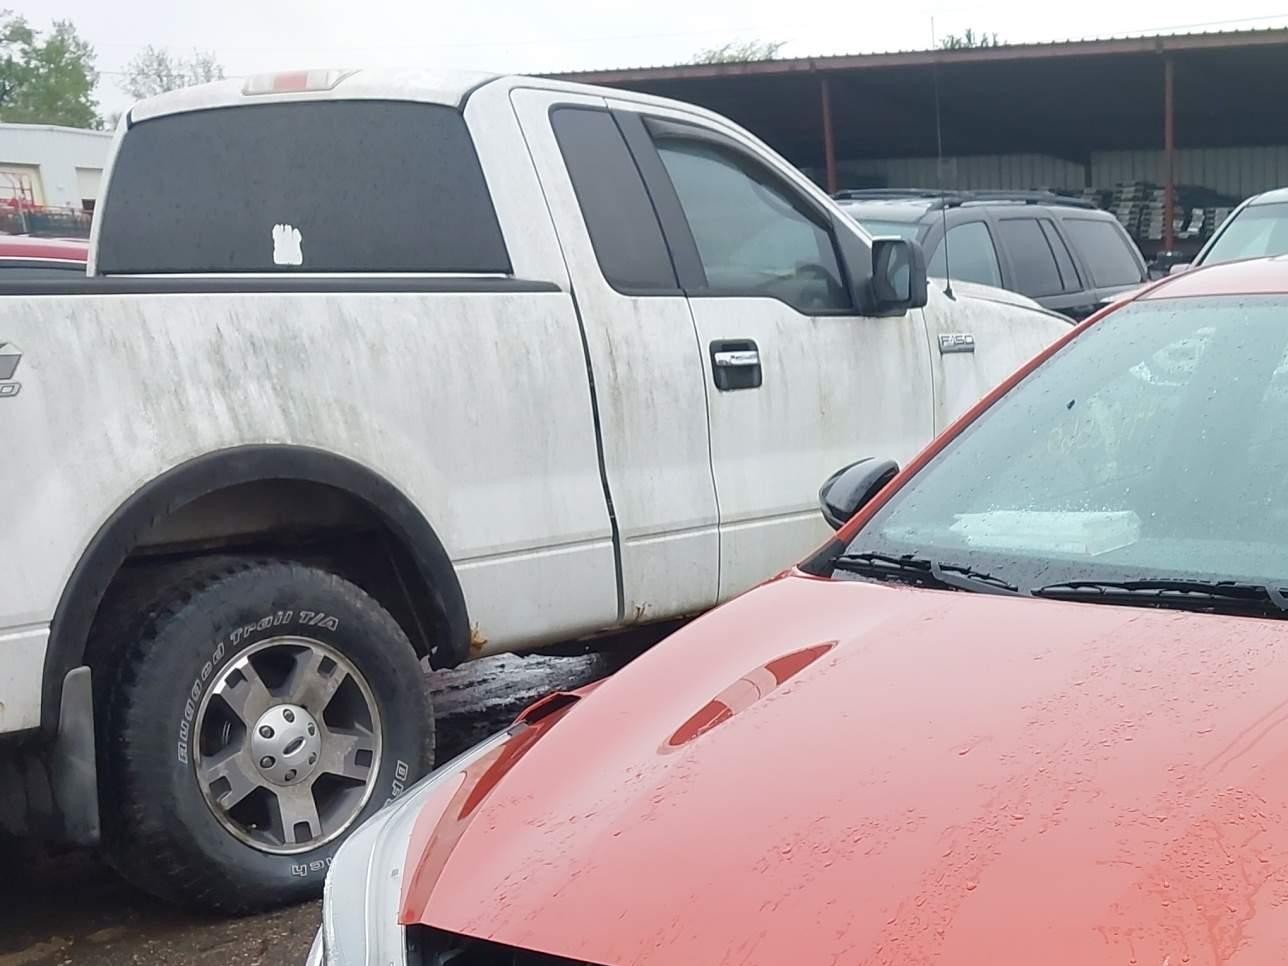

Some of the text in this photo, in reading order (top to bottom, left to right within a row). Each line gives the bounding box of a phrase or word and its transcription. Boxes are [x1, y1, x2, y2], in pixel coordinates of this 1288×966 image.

[177, 610, 339, 765] Rugged Trail T/A
